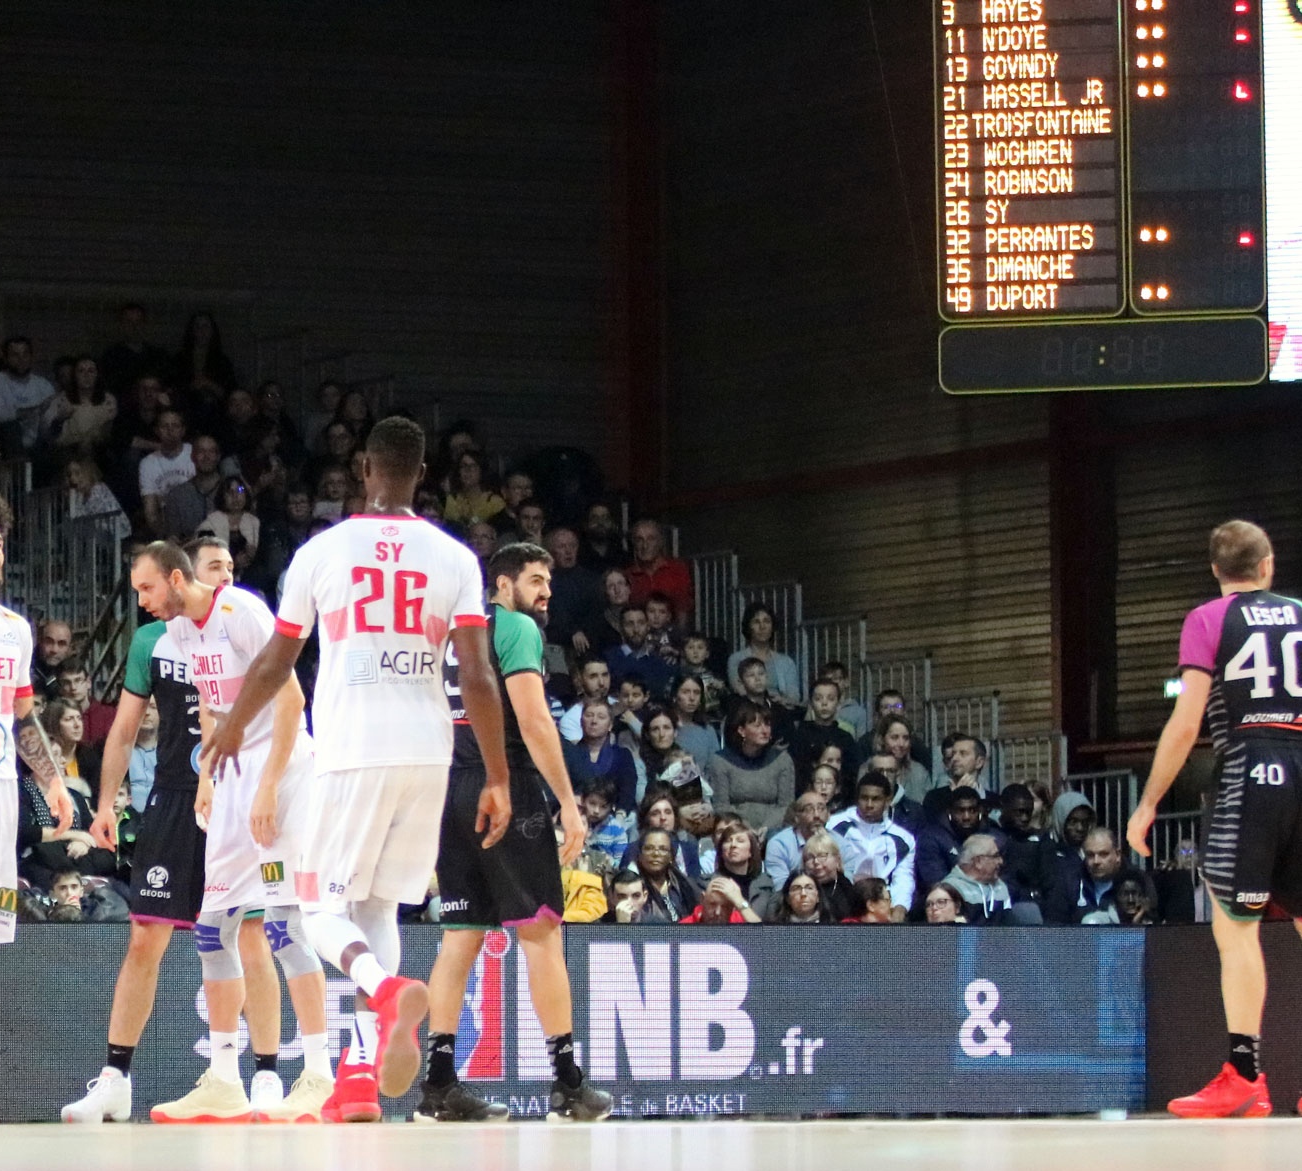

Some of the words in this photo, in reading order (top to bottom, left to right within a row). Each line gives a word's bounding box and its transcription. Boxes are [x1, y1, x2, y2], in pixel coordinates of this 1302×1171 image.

[942, 0, 955, 25] 3
[981, 0, 1043, 23] HAYES
[945, 28, 965, 53] 11
[982, 24, 1047, 52] N'DOYE
[946, 56, 968, 82] 13
[982, 53, 1059, 81] GOVINDY
[943, 86, 966, 111] 21
[982, 81, 1067, 109] HASSELL
[1080, 78, 1104, 105] JR
[944, 113, 968, 140] 22
[971, 108, 1112, 138] TROISFONTAINE
[944, 143, 969, 168] 23
[984, 139, 1072, 167] WOGHIREN
[945, 171, 970, 197] 24
[984, 167, 1073, 195] ROBINSON
[945, 199, 970, 226] 26
[985, 199, 1009, 225] SY
[946, 228, 970, 255] 32
[985, 224, 1094, 254] PERRANTES
[946, 257, 971, 284] 35
[986, 254, 1074, 282] DIMANCHE
[946, 286, 971, 312] 49
[986, 284, 1058, 311] DUPORT
[375, 541, 405, 564] SY
[351, 566, 429, 636] 26
[1240, 605, 1298, 626] LESCA
[380, 650, 436, 676] AGIR
[1249, 762, 1286, 786] 40
[139, 889, 172, 900] GEODIS
[959, 978, 1013, 1058] &
[665, 1093, 748, 1114] BASKET
